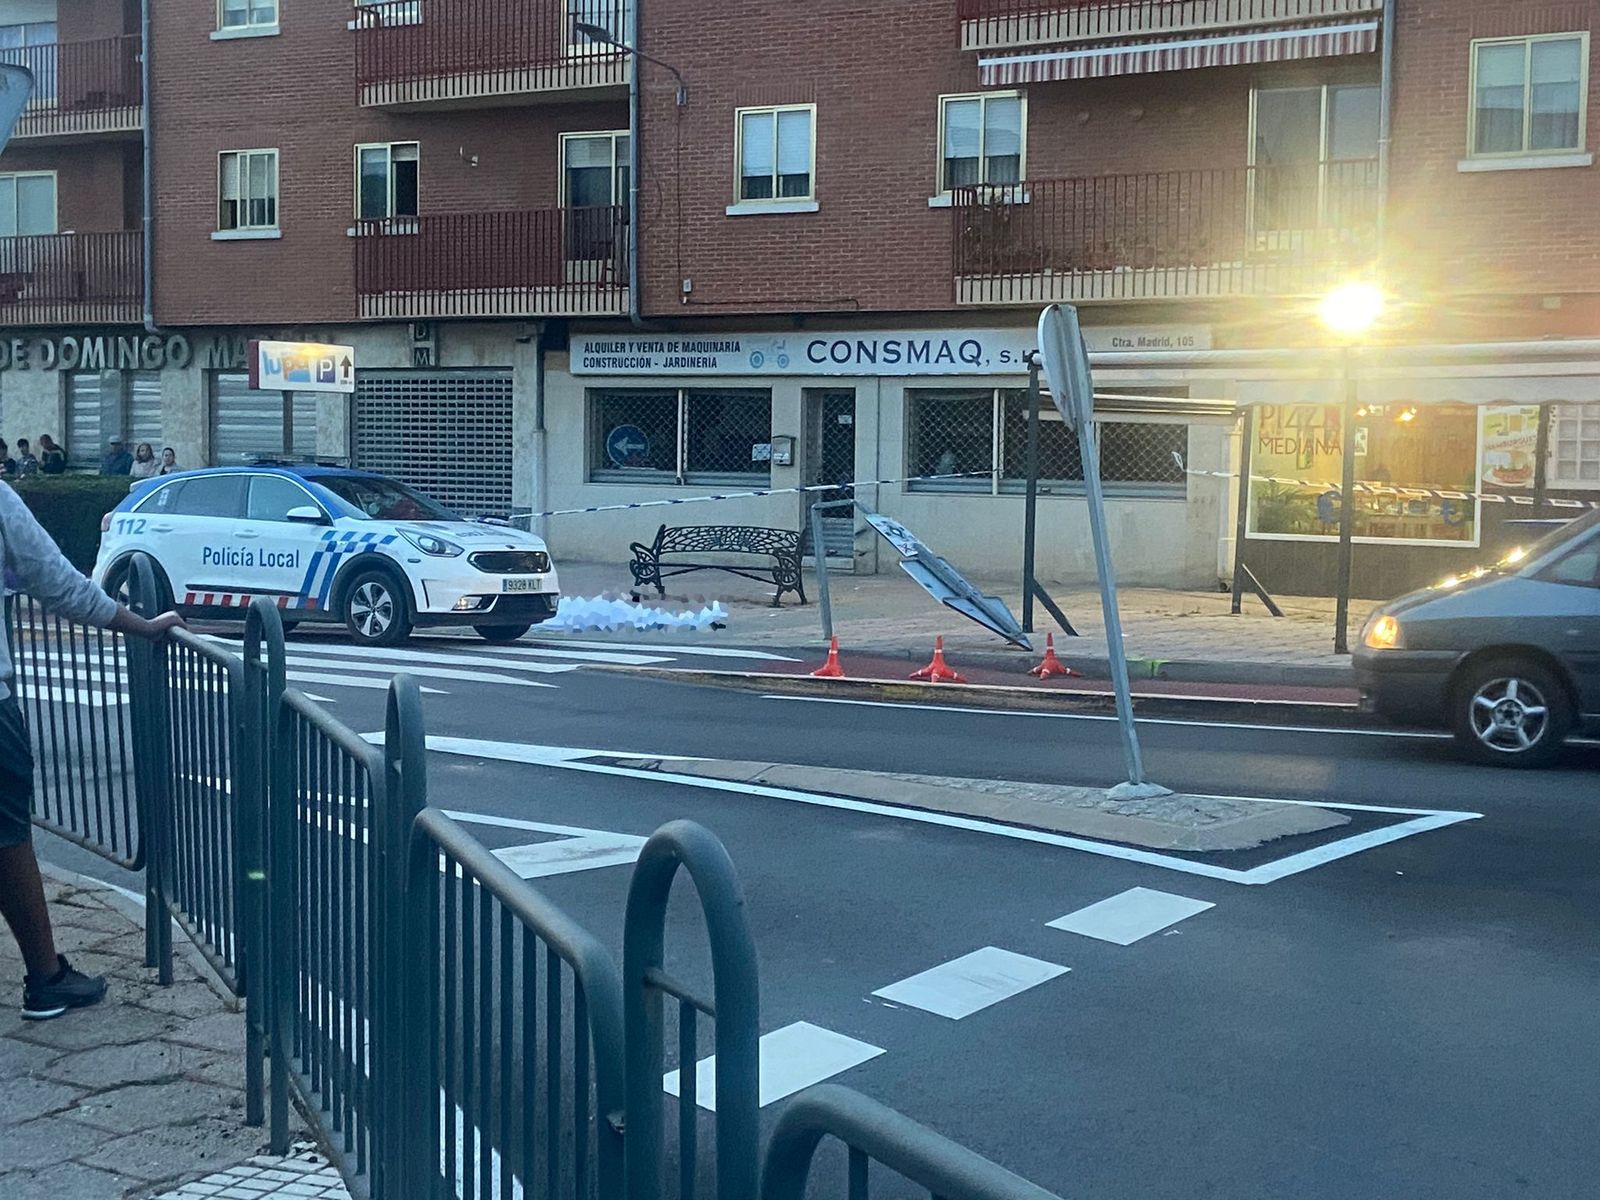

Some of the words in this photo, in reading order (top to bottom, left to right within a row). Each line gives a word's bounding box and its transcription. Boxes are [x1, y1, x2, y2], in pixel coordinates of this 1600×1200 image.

[584, 342, 626, 354] ALQUILER
[629, 342, 636, 353] Y
[636, 342, 665, 353] VENTA
[667, 342, 679, 353] DE
[681, 341, 741, 353] MAQUINARIA
[1112, 337, 1135, 348] Ctra.
[1137, 337, 1174, 348] Madrid,
[1177, 336, 1194, 347] 105
[38, 335, 191, 370] DOMINGO
[807, 339, 990, 367] CONSMAQ,
[319, 359, 333, 380] P
[583, 357, 651, 368] CONSTRUCCION
[663, 357, 717, 368] JARDINERIA
[1259, 437, 1343, 456] MEDIANA
[116, 518, 147, 535] 112
[203, 547, 254, 567] Policía
[259, 548, 300, 568] Local
